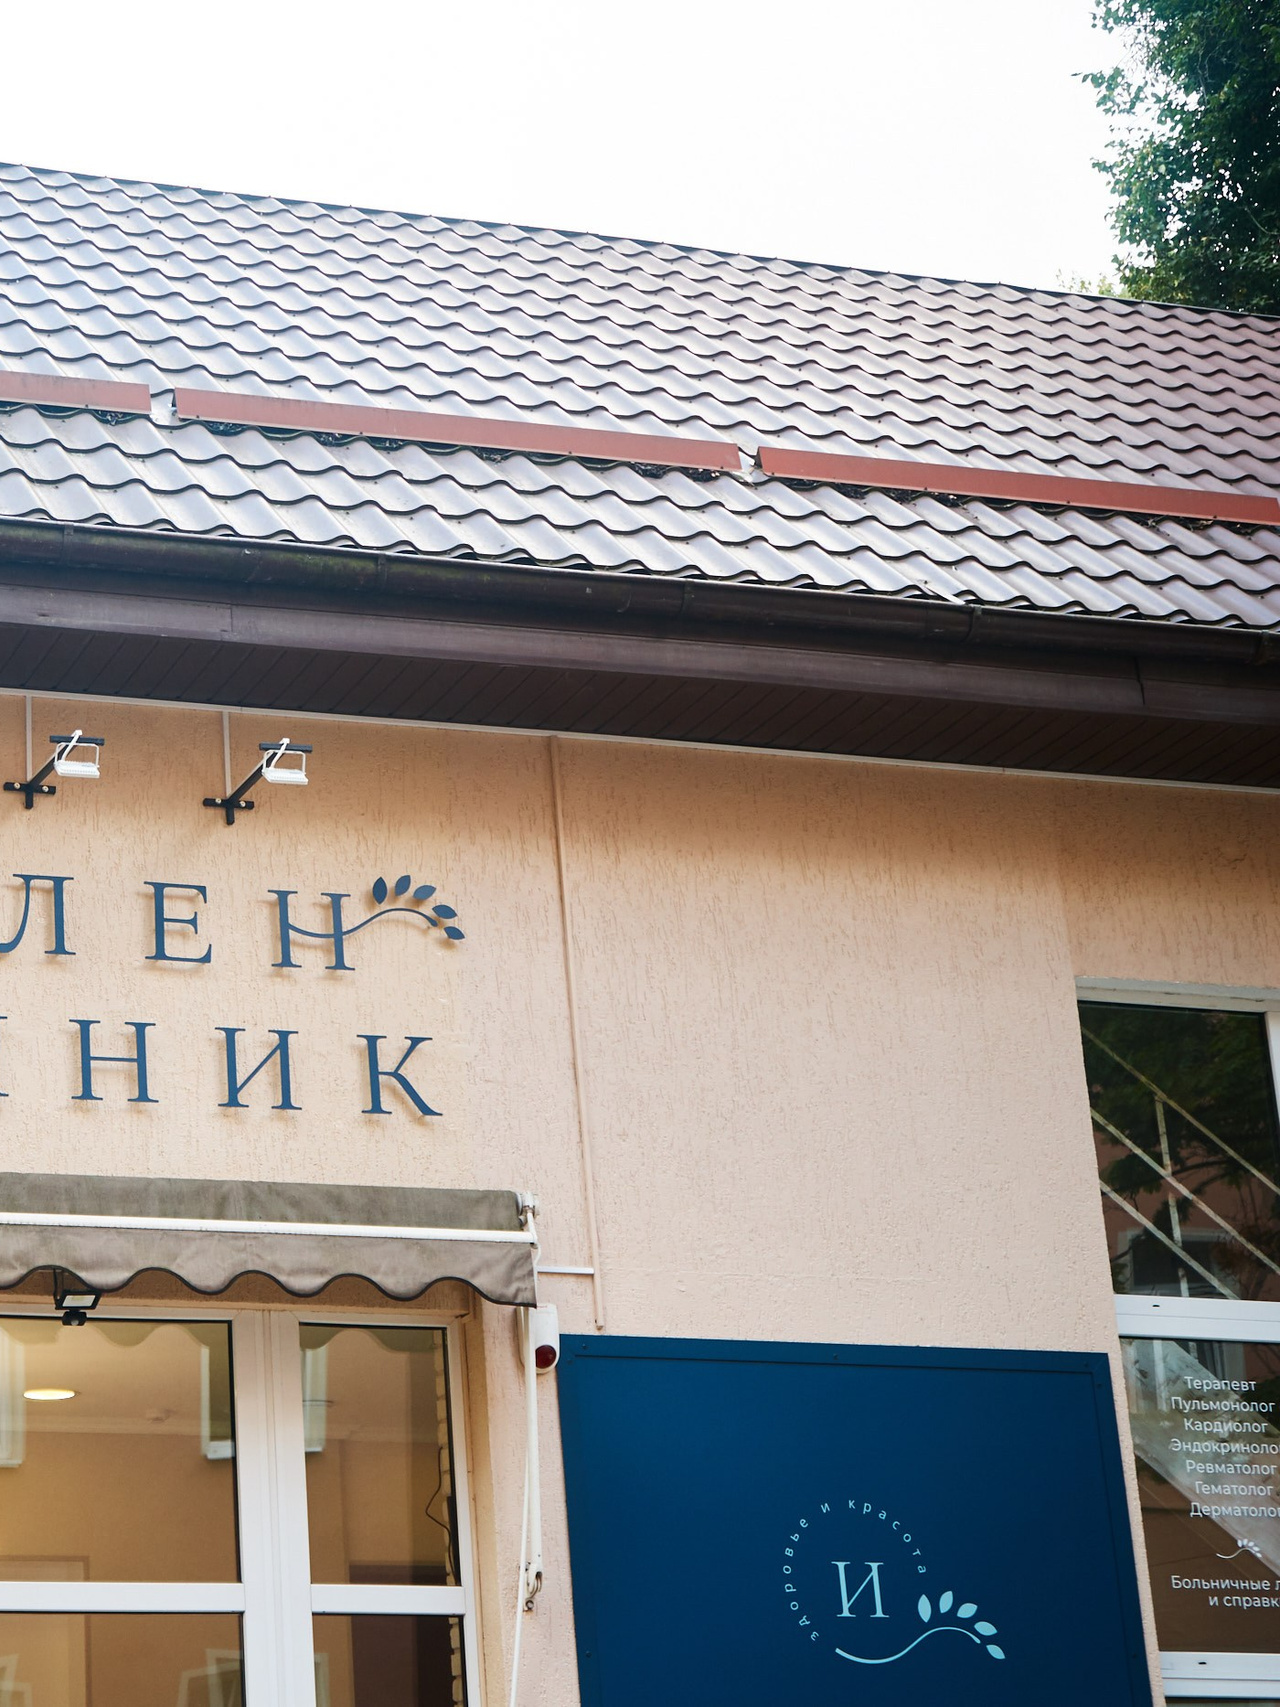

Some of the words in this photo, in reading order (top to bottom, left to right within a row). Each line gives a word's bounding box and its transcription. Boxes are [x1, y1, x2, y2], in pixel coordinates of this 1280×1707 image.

[1183, 1376, 1257, 1392] Терапевт
[1171, 1396, 1276, 1413] Пульмонолог
[1183, 1418, 1269, 1434] Кардиолог
[1170, 1438, 1280, 1455] Эндокриноло
[1185, 1460, 1278, 1475] Ревматолог
[1195, 1481, 1274, 1496] Гематолог
[782, 1518, 820, 1642] здоровье
[820, 1502, 831, 1514] и
[848, 1499, 927, 1574] красота
[830, 1561, 890, 1618] И
[1170, 1575, 1271, 1591] Больничные
[1208, 1595, 1219, 1607] и
[1223, 1595, 1280, 1610] справк
